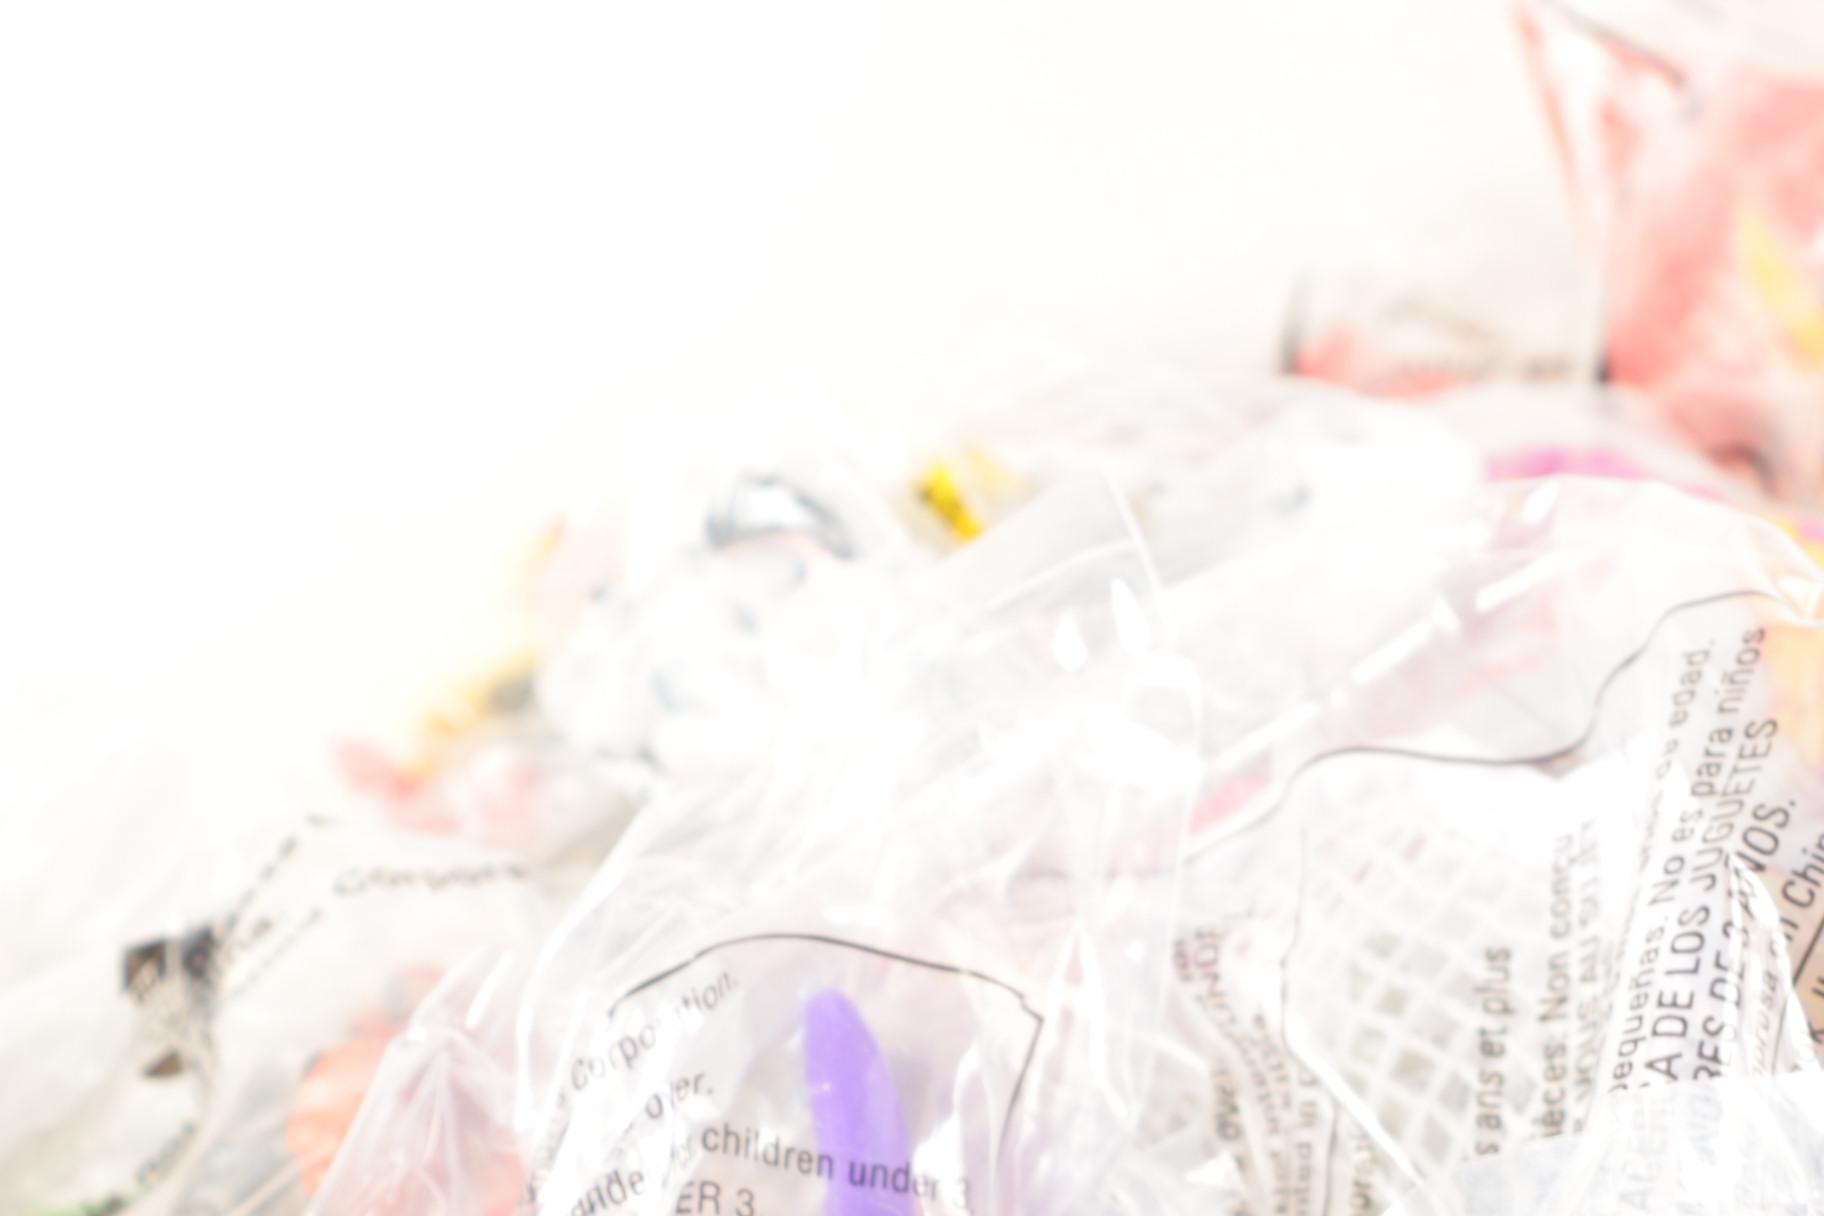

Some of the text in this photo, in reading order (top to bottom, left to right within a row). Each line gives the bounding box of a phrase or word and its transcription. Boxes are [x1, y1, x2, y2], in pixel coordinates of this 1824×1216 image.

[1690, 723, 1736, 798] para
[1716, 627, 1766, 714] niños
[1691, 719, 1778, 895] JUGUETES
[1671, 904, 1713, 976] LOS
[701, 1122, 940, 1201] children under
